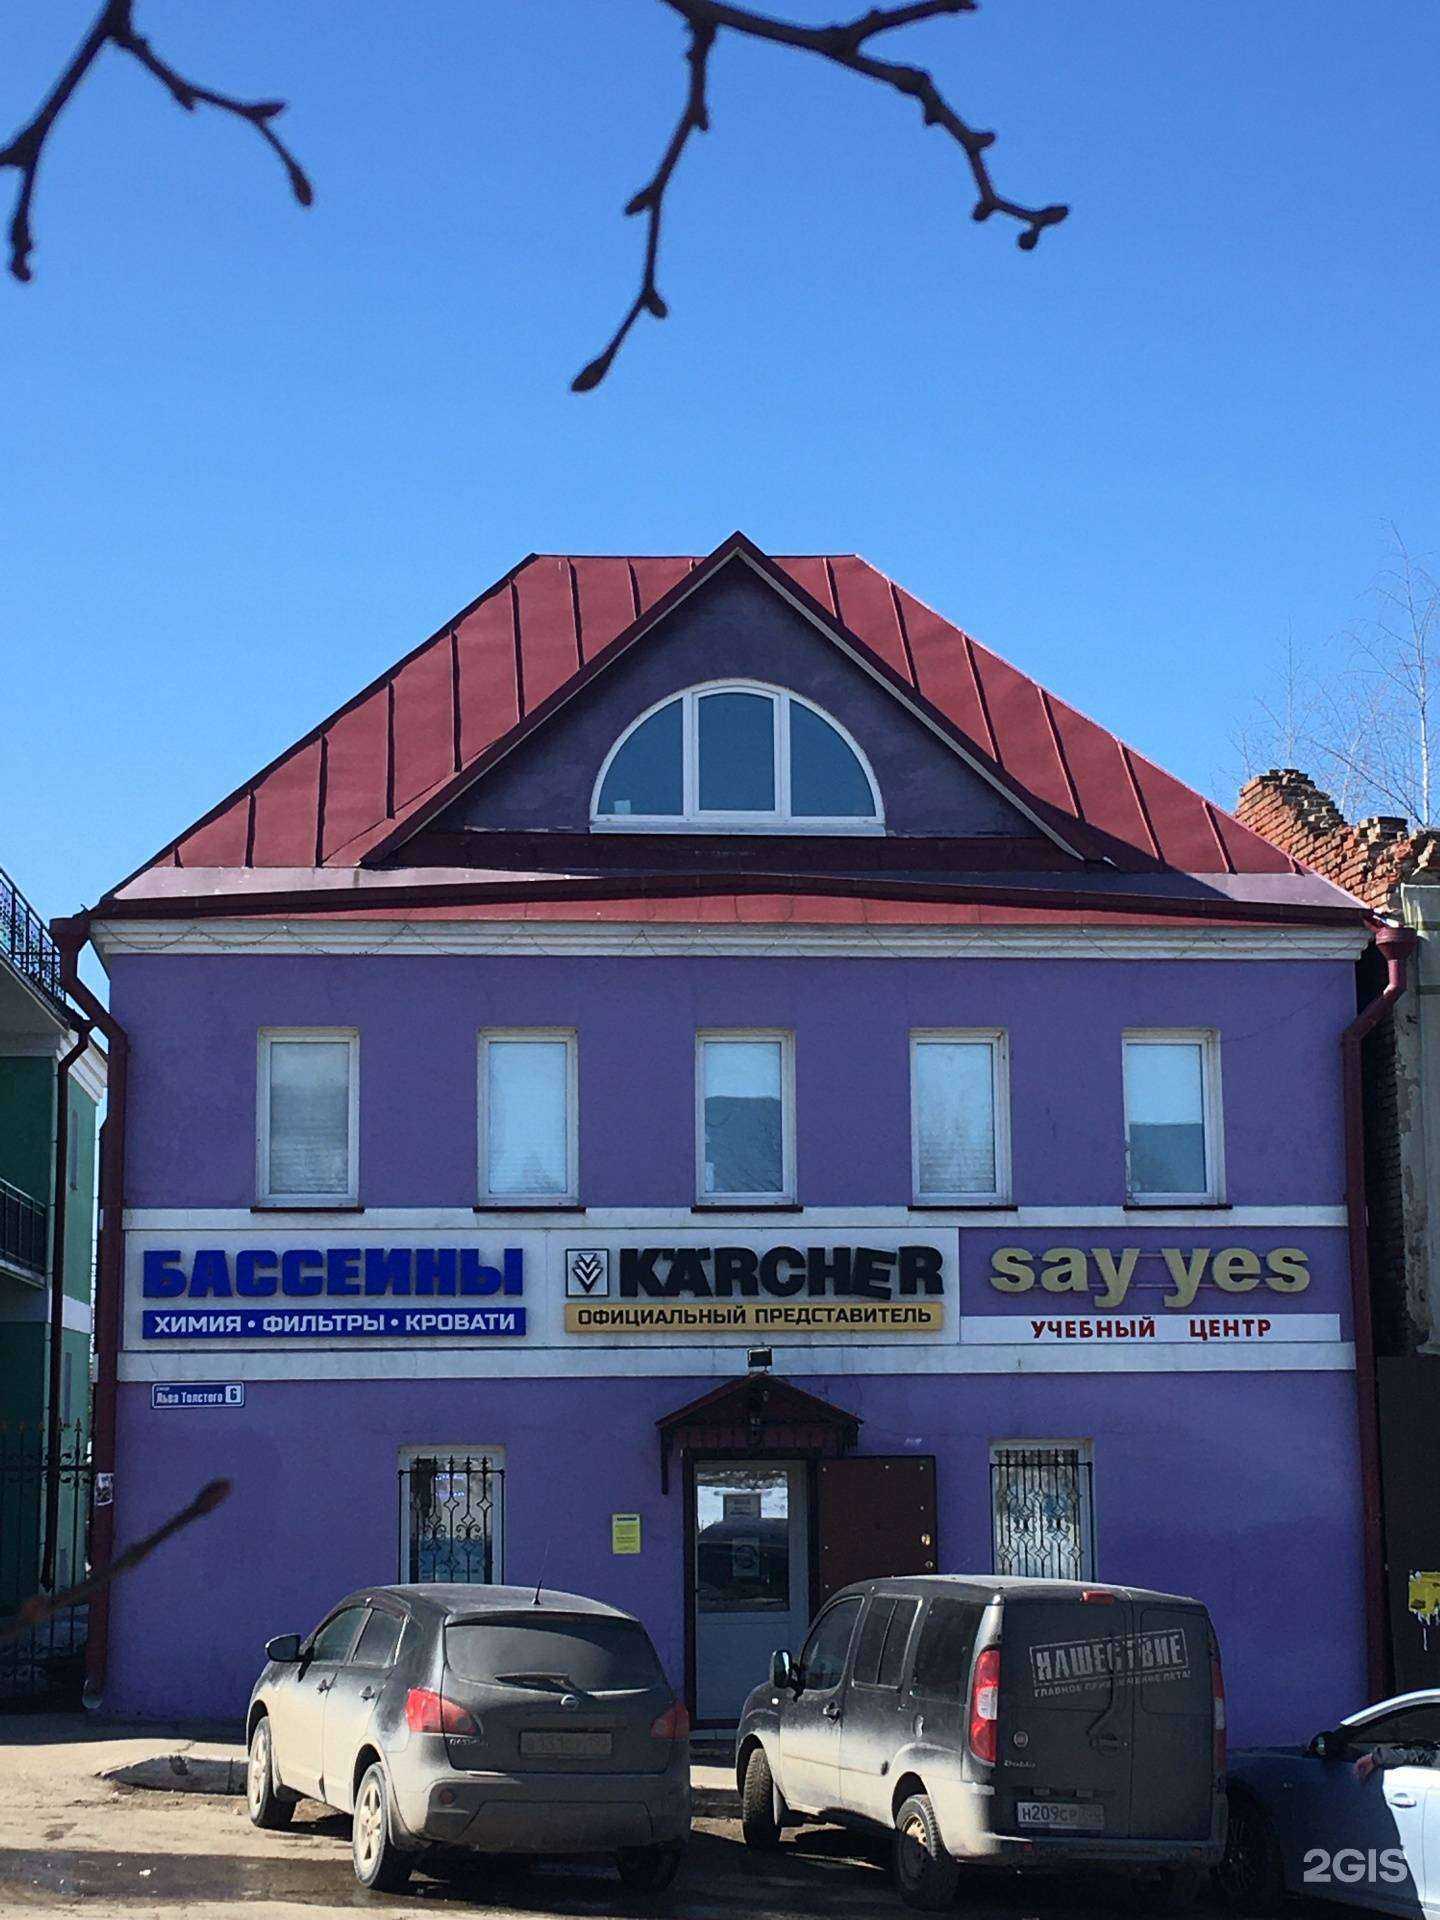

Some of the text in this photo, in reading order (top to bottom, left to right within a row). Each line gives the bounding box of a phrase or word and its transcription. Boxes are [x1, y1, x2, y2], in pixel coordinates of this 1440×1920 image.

[989, 1247, 1311, 1308] say yes
[154, 1313, 516, 1333] ХИМИЯ ФИЛЬТРЫ КРОВАТИ
[577, 1304, 932, 1326] ОФИЦИАЛЬНЫЙ ПРЕДСТАВИТЕЛЬ
[1030, 1316, 1272, 1341] УЧЕБНЫЙ ЦЕНТР
[181, 1391, 224, 1403] Толстого
[229, 1388, 238, 1401] 6
